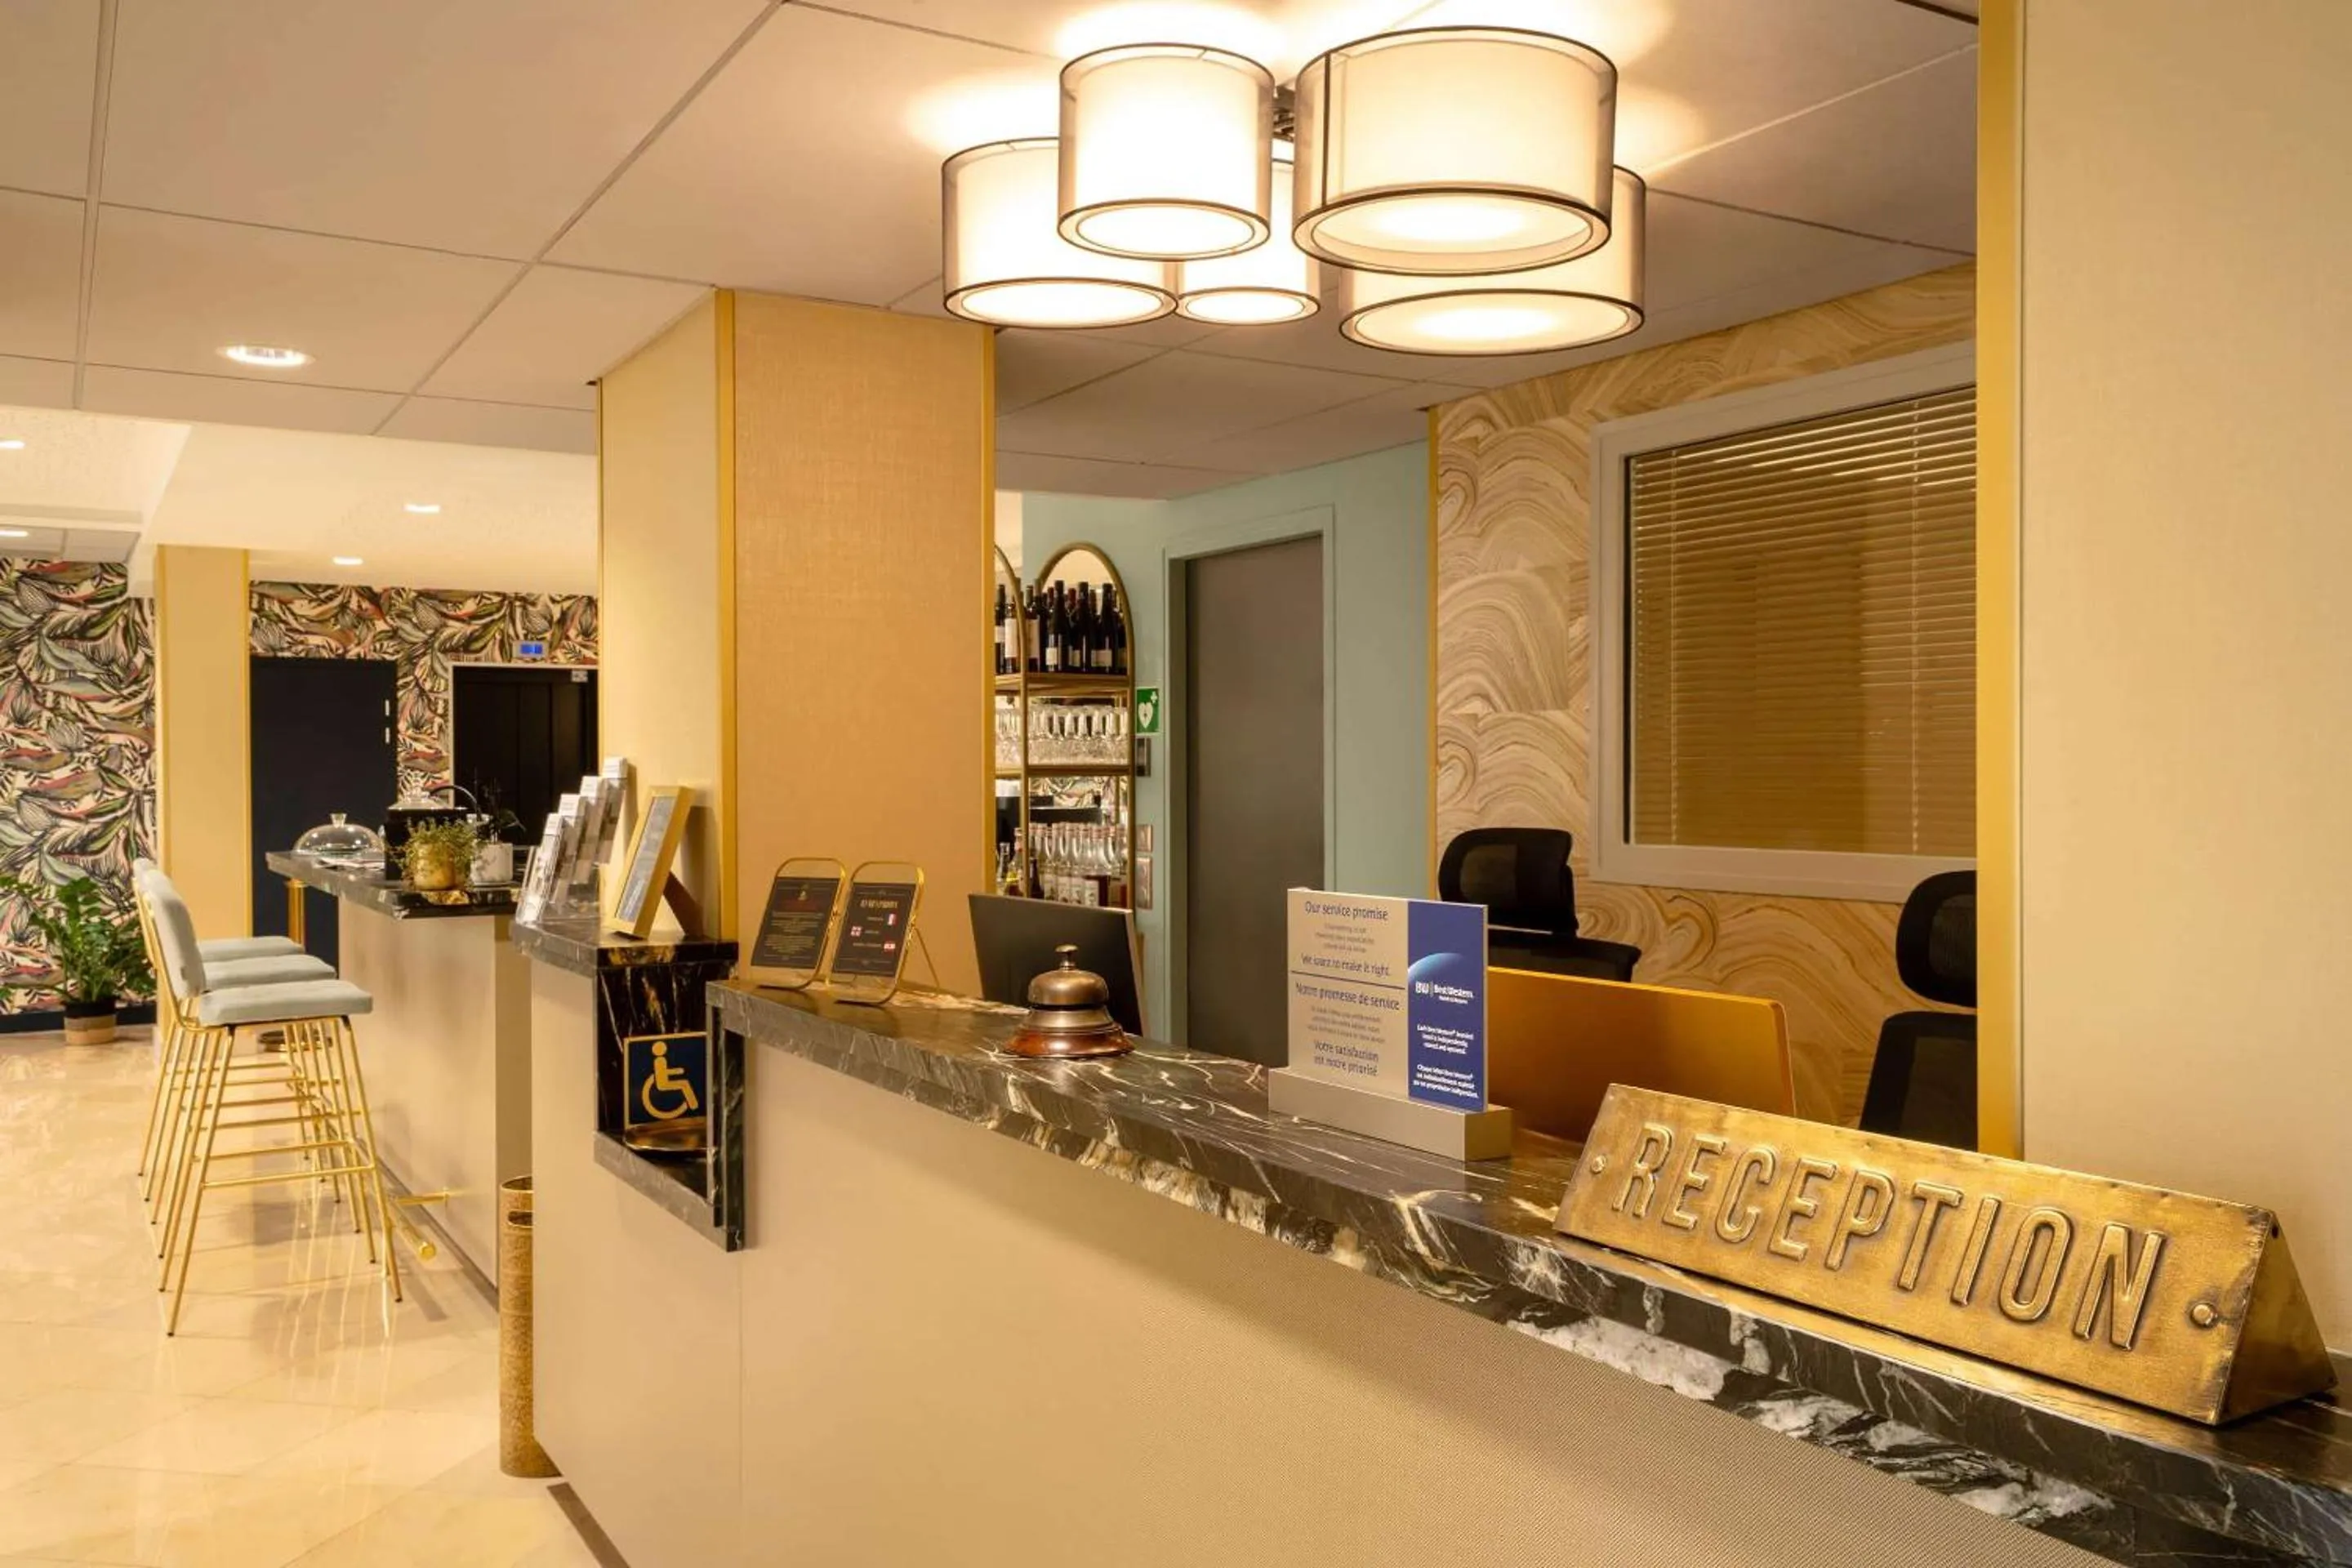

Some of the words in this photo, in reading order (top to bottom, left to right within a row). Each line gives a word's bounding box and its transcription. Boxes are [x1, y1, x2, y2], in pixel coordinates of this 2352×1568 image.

[1323, 903, 1351, 916] service
[1352, 906, 1388, 920] promise
[1320, 988, 1356, 1003] promesse
[1359, 994, 1369, 1006] de
[1370, 996, 1400, 1011] service
[1611, 1122, 2167, 1353] RECEPTION
